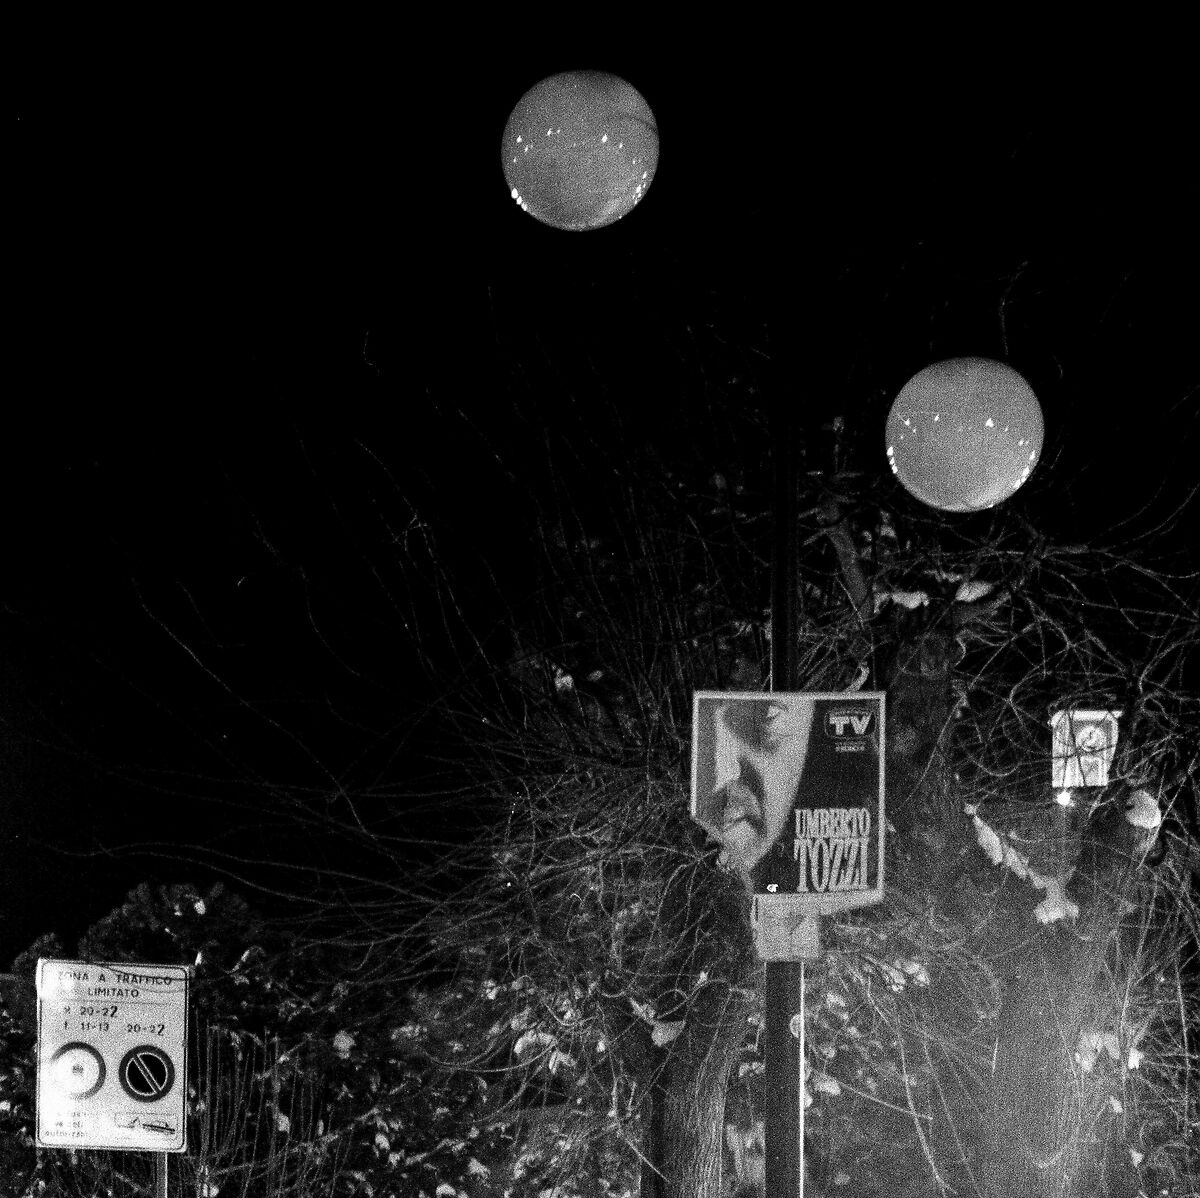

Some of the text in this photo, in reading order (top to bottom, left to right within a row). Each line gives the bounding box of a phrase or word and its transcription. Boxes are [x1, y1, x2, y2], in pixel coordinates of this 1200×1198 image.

[829, 713, 872, 736] TV
[794, 807, 871, 838] UMBERTO
[793, 838, 869, 893] TOZZI
[99, 973, 106, 983] A
[117, 974, 173, 985] TRAFFICO
[88, 988, 139, 998] LIMITATO
